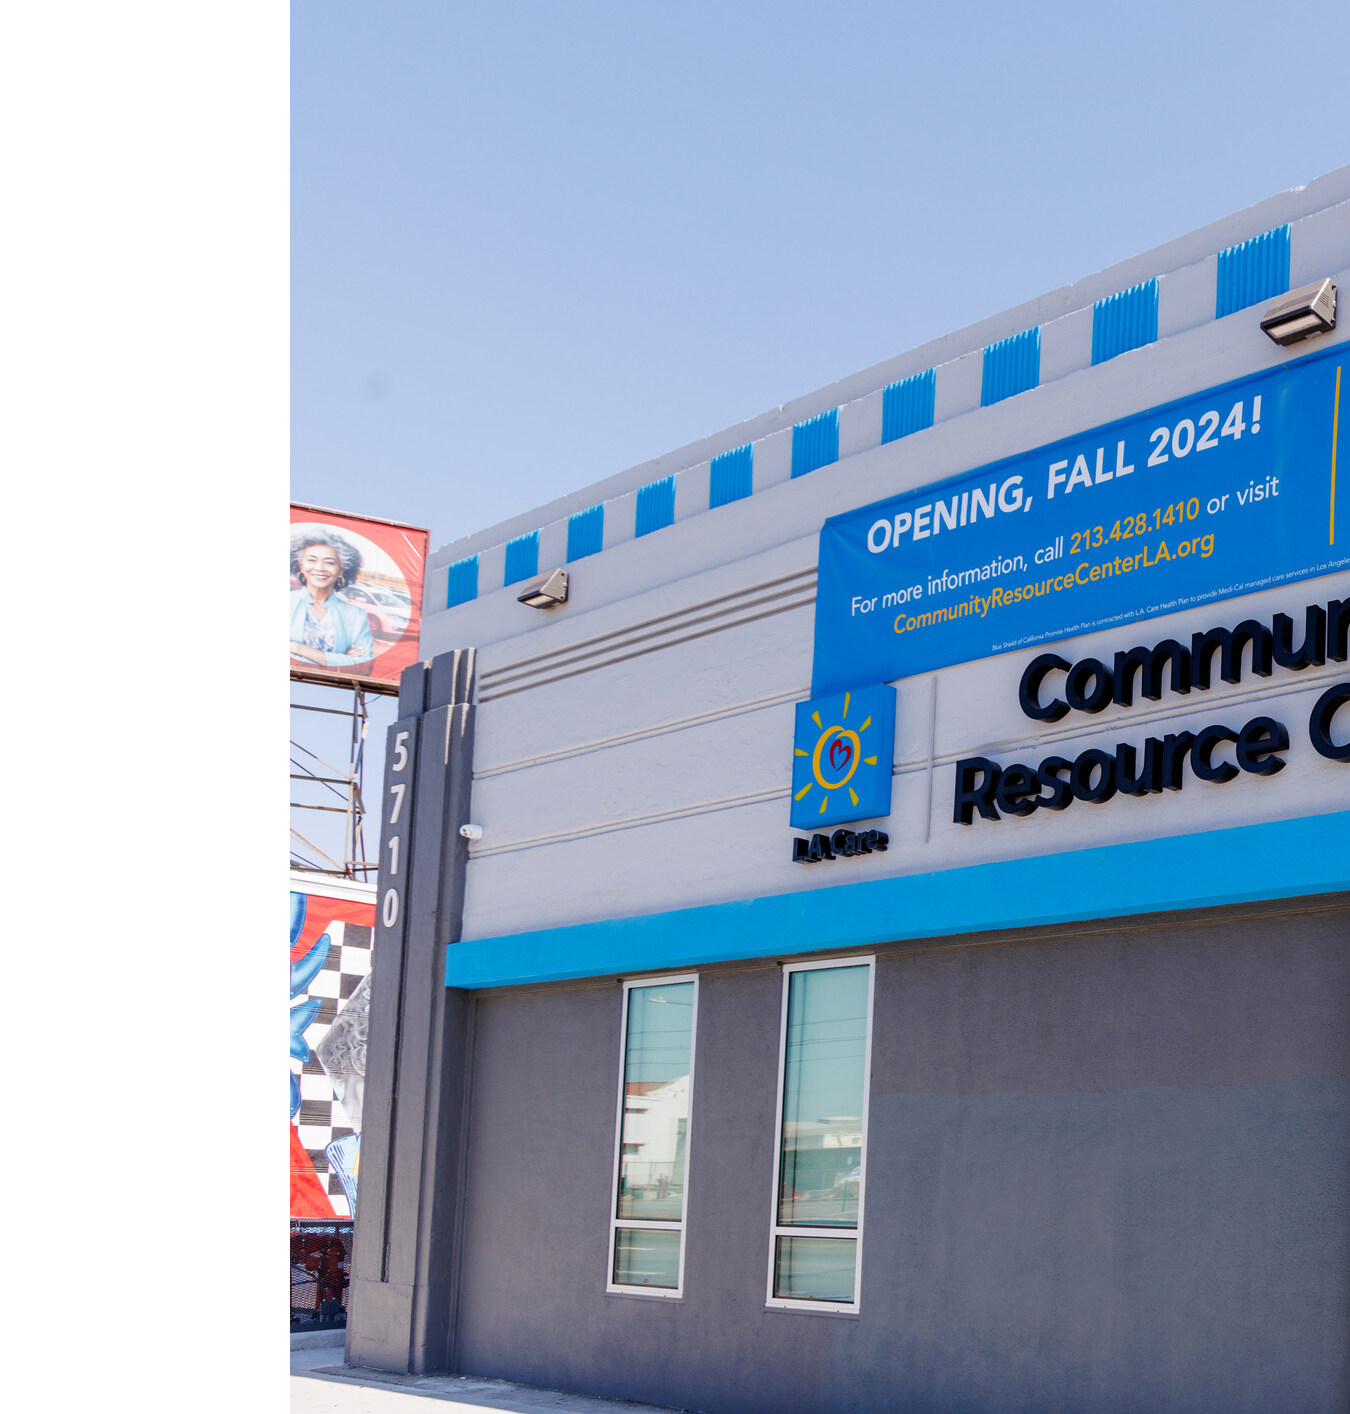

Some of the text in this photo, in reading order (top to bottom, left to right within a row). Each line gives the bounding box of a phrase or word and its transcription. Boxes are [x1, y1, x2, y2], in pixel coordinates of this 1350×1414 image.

[867, 395, 1263, 554] OPENING, FALL 2024!
[851, 475, 1280, 616] For more information, call 213.428.1410 or visit
[893, 530, 1215, 634] CommunityResourceCenterLA.org
[1022, 633, 1044, 644] California
[1045, 629, 1063, 639] Promise
[1064, 624, 1080, 634] Health
[1080, 622, 1091, 631] Plan
[1096, 613, 1123, 625] contracted
[1123, 611, 1134, 619] with
[1146, 605, 1160, 613] Care
[1160, 600, 1177, 611] Health
[1178, 597, 1190, 606] Plan
[1197, 589, 1218, 602] provide
[1218, 581, 1244, 595] Medi-Cal
[1244, 576, 1272, 589] managed
[1272, 574, 1285, 582] care
[1285, 567, 1309, 579] services
[1316, 562, 1327, 571] Los
[953, 715, 1290, 826] Resource
[382, 731, 410, 928] 5710
[830, 829, 889, 857] Care
